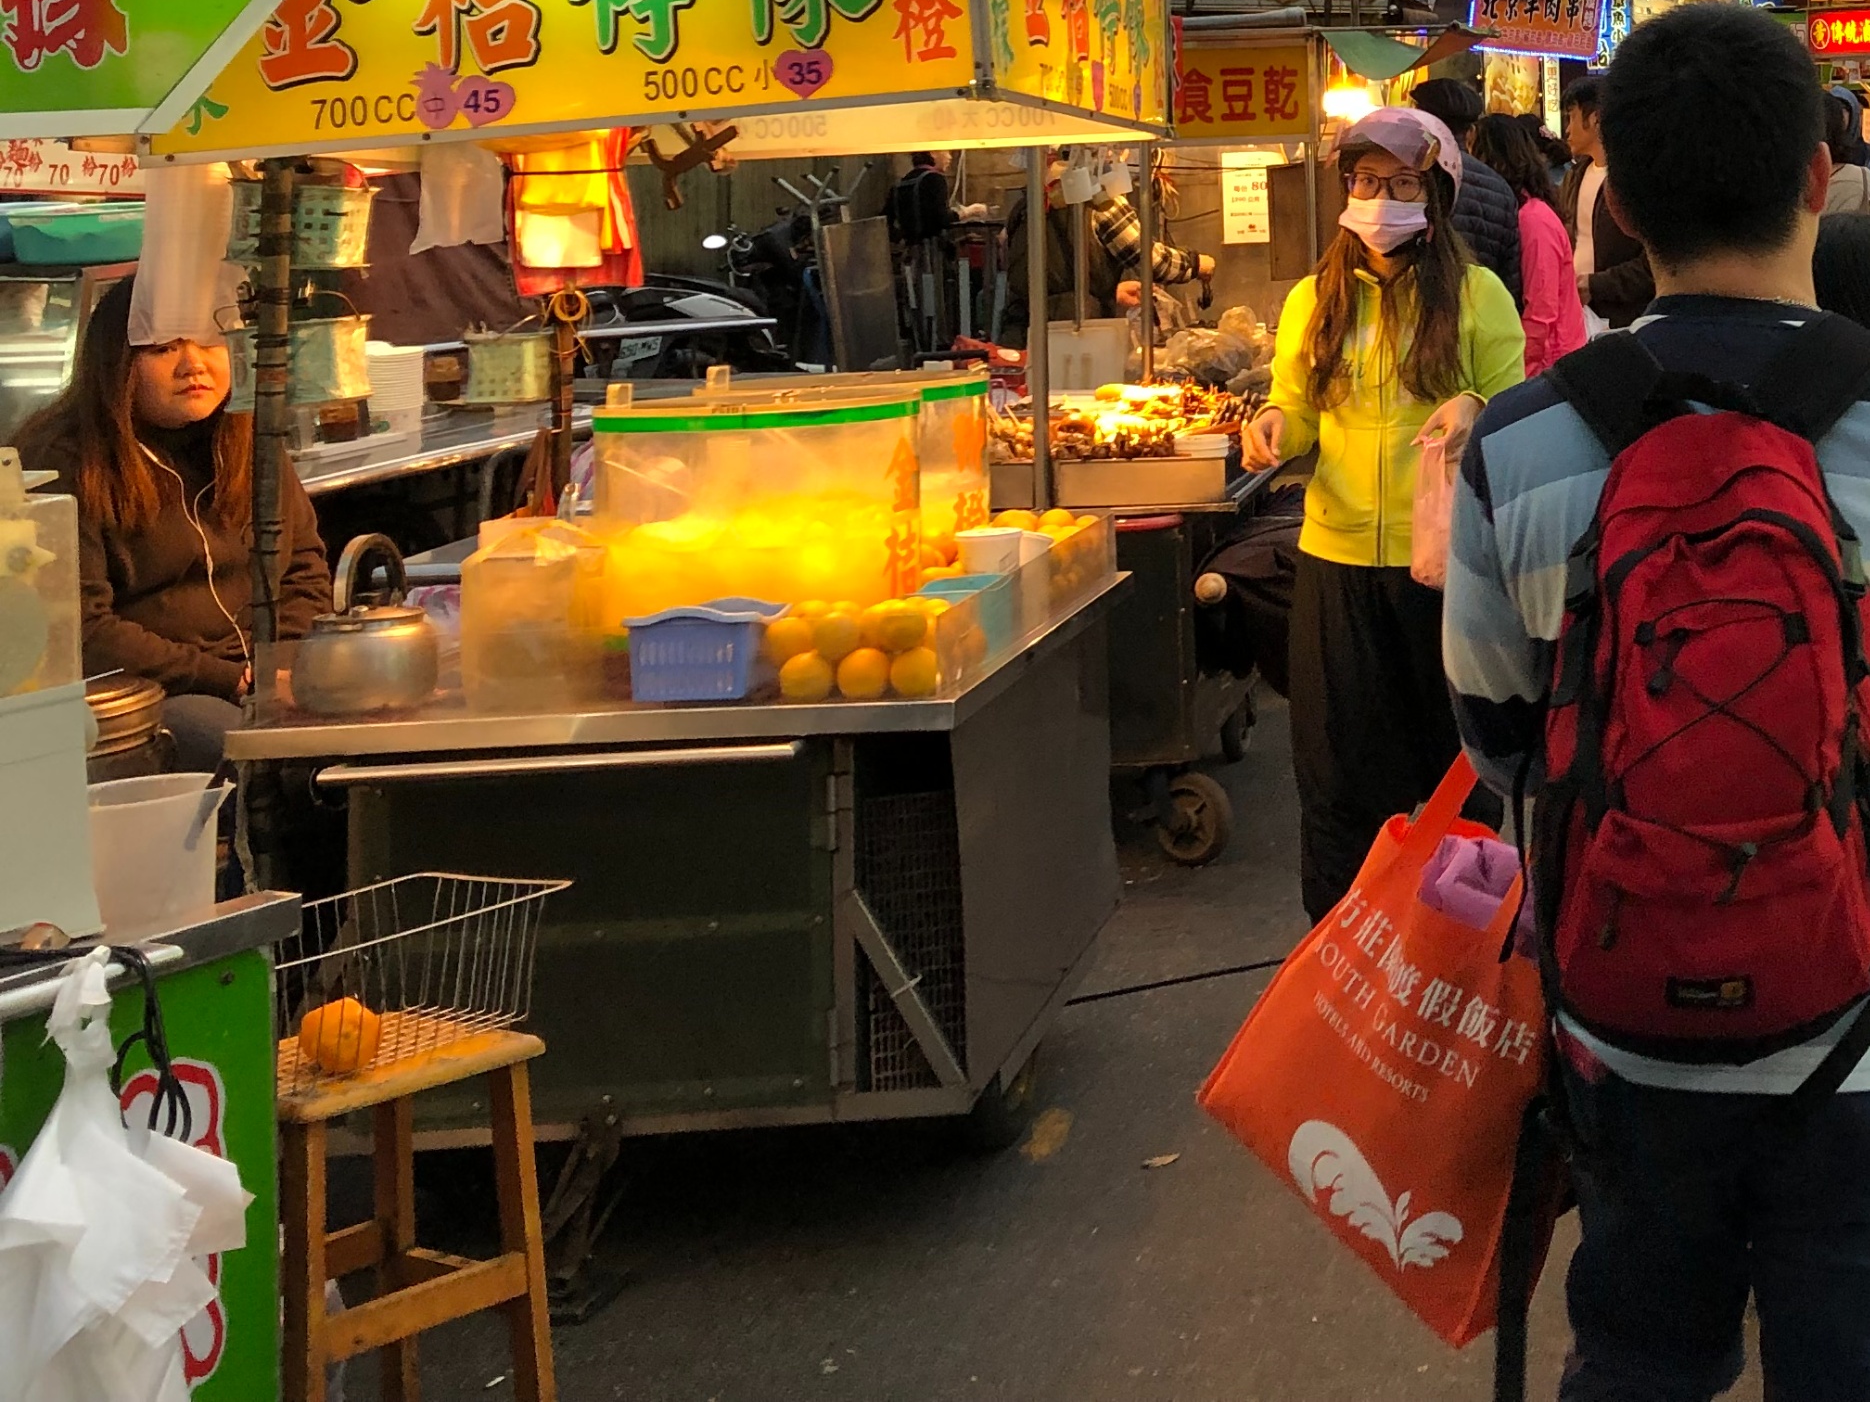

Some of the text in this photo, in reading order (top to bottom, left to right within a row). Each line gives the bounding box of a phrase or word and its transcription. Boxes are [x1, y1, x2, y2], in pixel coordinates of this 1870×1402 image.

[643, 64, 742, 101] 500CC
[787, 57, 824, 87] 35
[1179, 64, 1300, 125] 食豆乾
[310, 93, 416, 127] 700CC
[462, 86, 502, 114] 45
[99, 164, 120, 185] 70
[884, 437, 921, 599] 金桔
[1374, 1003, 1481, 1090] GARDEN
